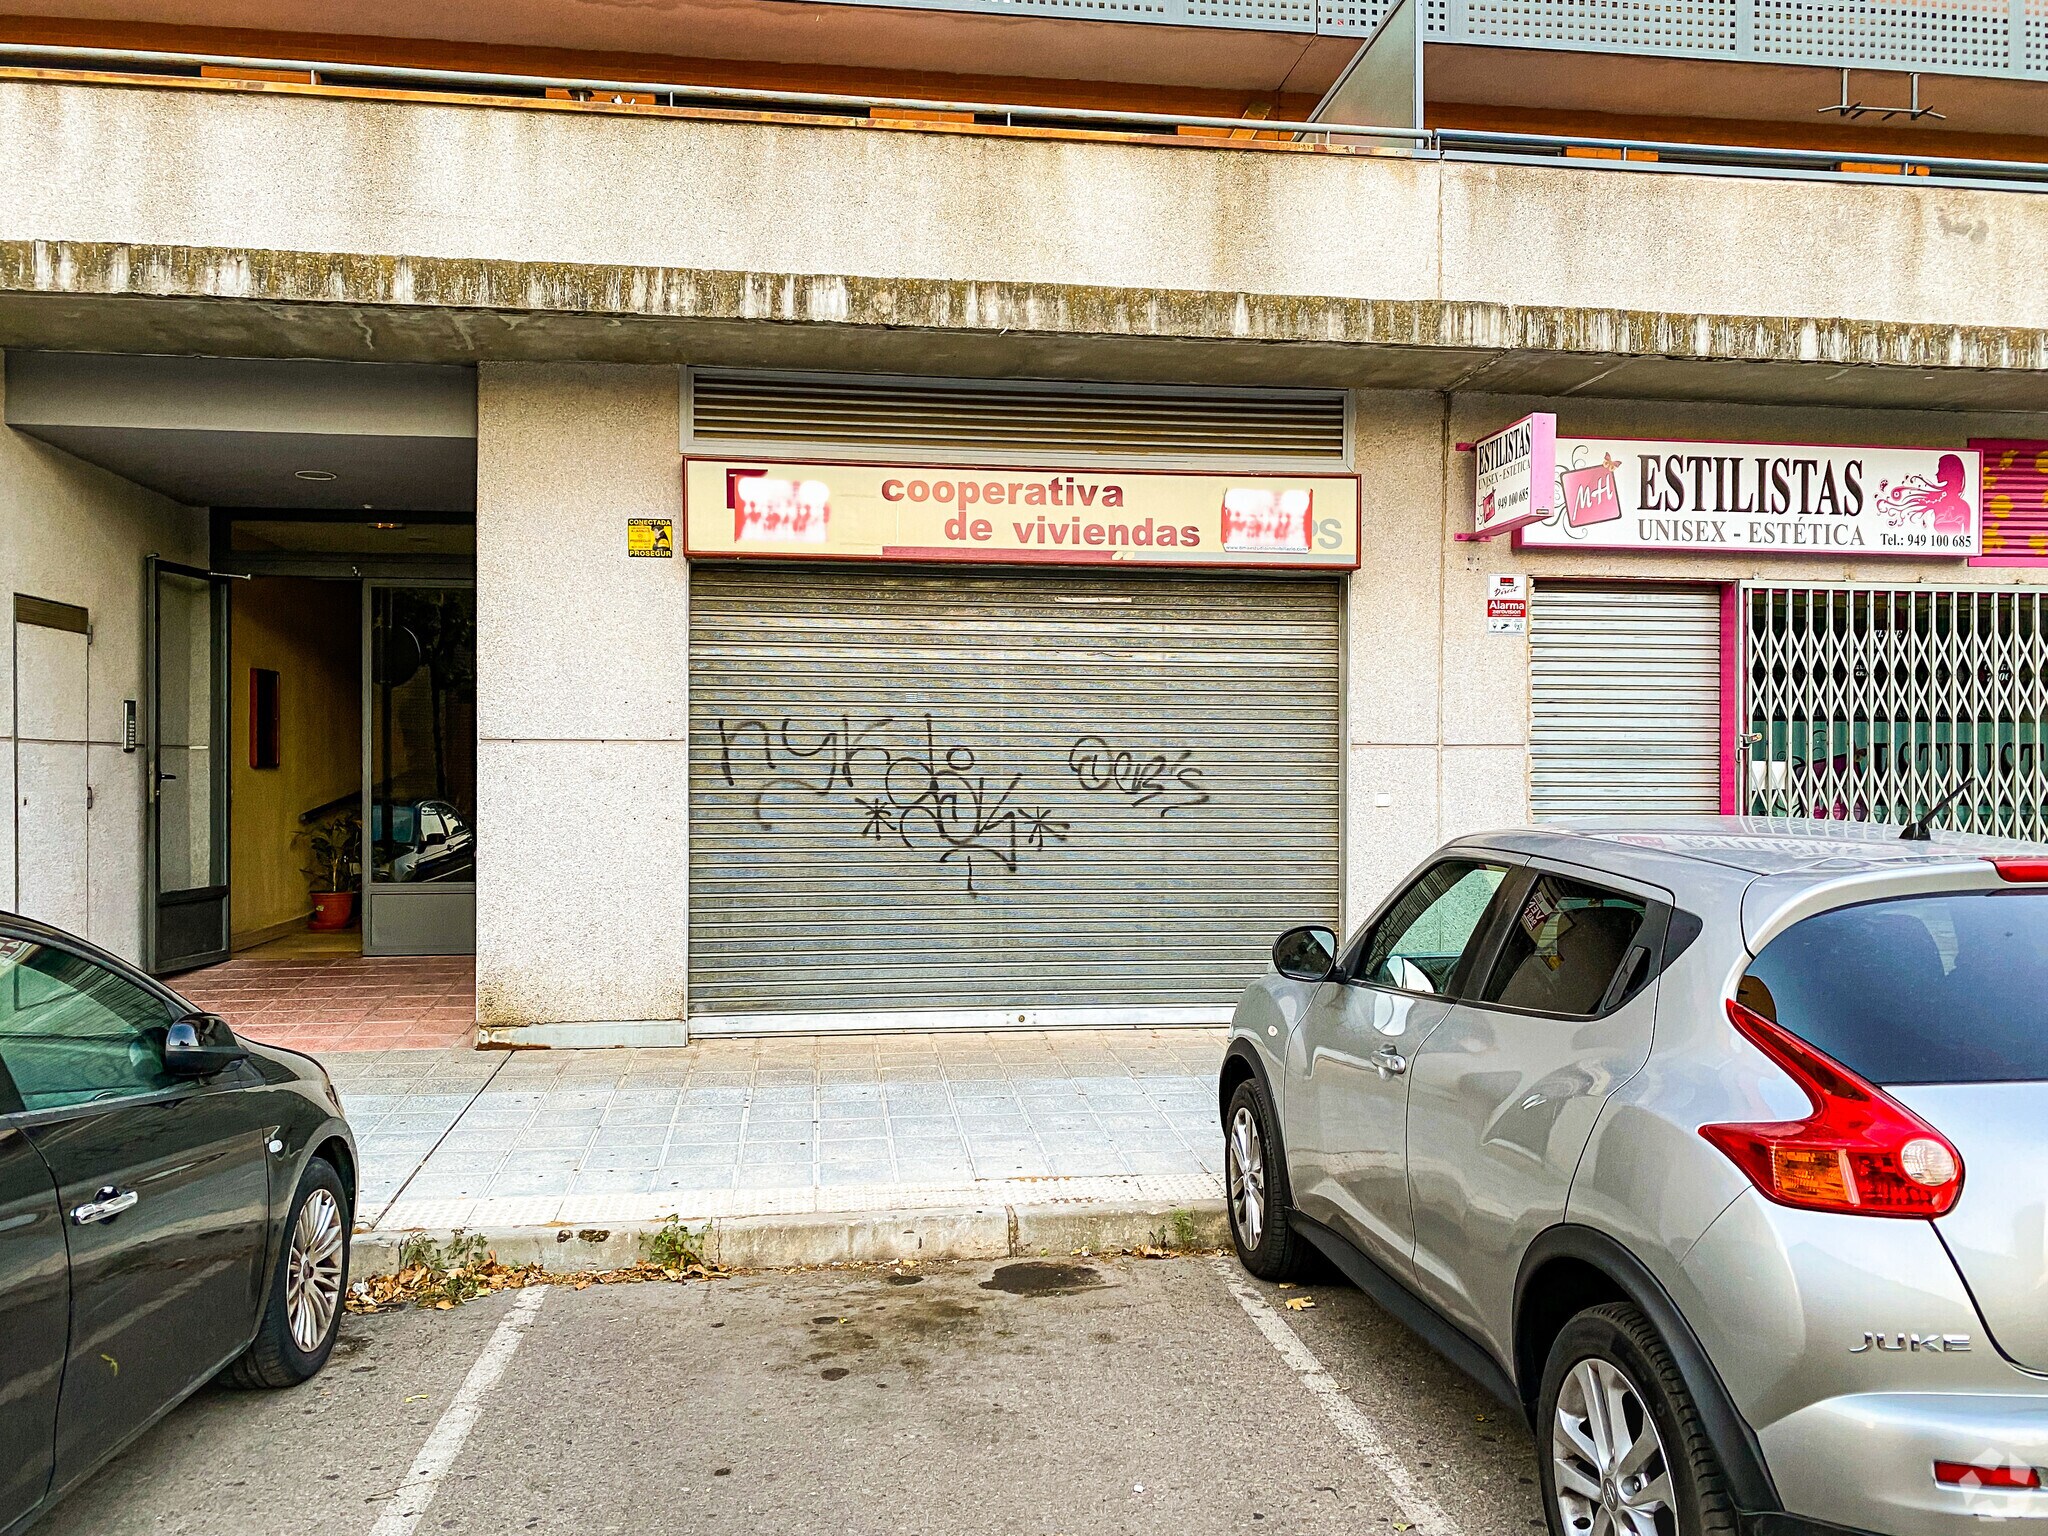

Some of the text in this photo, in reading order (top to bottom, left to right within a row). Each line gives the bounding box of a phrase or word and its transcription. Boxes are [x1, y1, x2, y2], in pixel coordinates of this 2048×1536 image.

[1478, 423, 1531, 476] ESTILISTAS
[881, 476, 1124, 510] cooperativa
[1478, 472, 1499, 490] UNISEX
[1637, 454, 1864, 516] ESTILISTAS
[1497, 486, 1529, 511] 949 100 685
[944, 511, 1201, 547] de viviendas
[1637, 518, 1727, 542] UNISEX
[1749, 517, 1866, 546] ESTÉTICA
[1880, 533, 1972, 548] Tel.: 949 100 685
[1489, 600, 1525, 610] Alarma
[1848, 1332, 1972, 1352] JUKE
